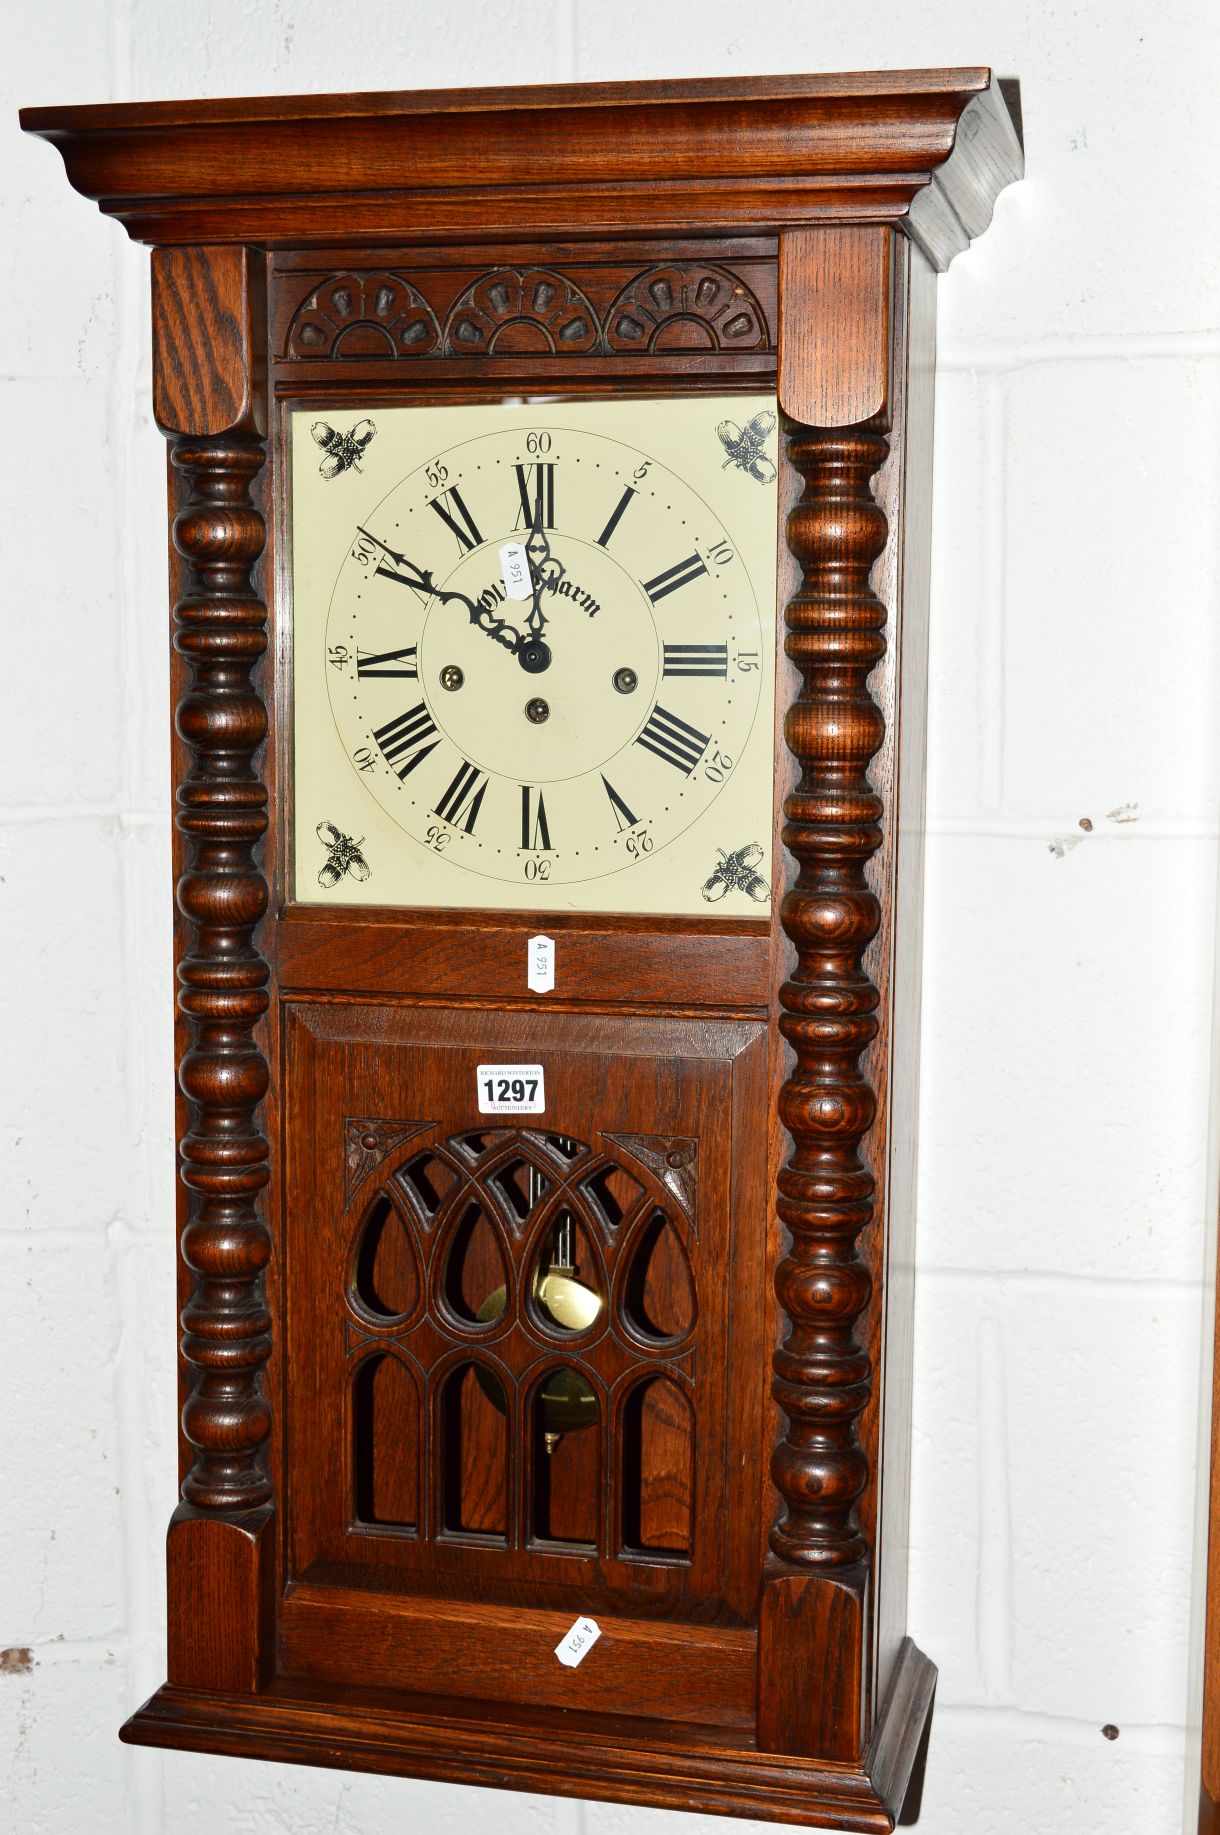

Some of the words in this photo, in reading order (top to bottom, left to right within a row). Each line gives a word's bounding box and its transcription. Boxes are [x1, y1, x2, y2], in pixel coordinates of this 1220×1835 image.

[526, 432, 552, 453] 60
[425, 459, 449, 488] 55
[634, 461, 653, 479] 5
[510, 463, 558, 531] XII
[426, 484, 488, 559] XI
[593, 484, 640, 550] I
[351, 538, 376, 566] 50
[709, 539, 734, 566] 10
[373, 553, 438, 611] X
[509, 564, 523, 583] 951
[639, 549, 710, 607] II
[328, 645, 349, 671] 45
[357, 642, 420, 682] IX
[662, 641, 728, 681] III
[737, 650, 759, 673] 15
[371, 698, 444, 784] VIII
[632, 701, 713, 779] IIII
[353, 747, 377, 773] 40
[704, 751, 733, 784] 20
[430, 758, 490, 836] VII
[601, 772, 643, 833] V
[518, 785, 556, 850] VI
[423, 826, 451, 852] 35
[626, 830, 654, 860] 25
[524, 859, 552, 881] 30
[536, 957, 547, 975] 951
[484, 1079, 538, 1102] 1297
[583, 1624, 592, 1633] A
[568, 1634, 585, 1653] 951
